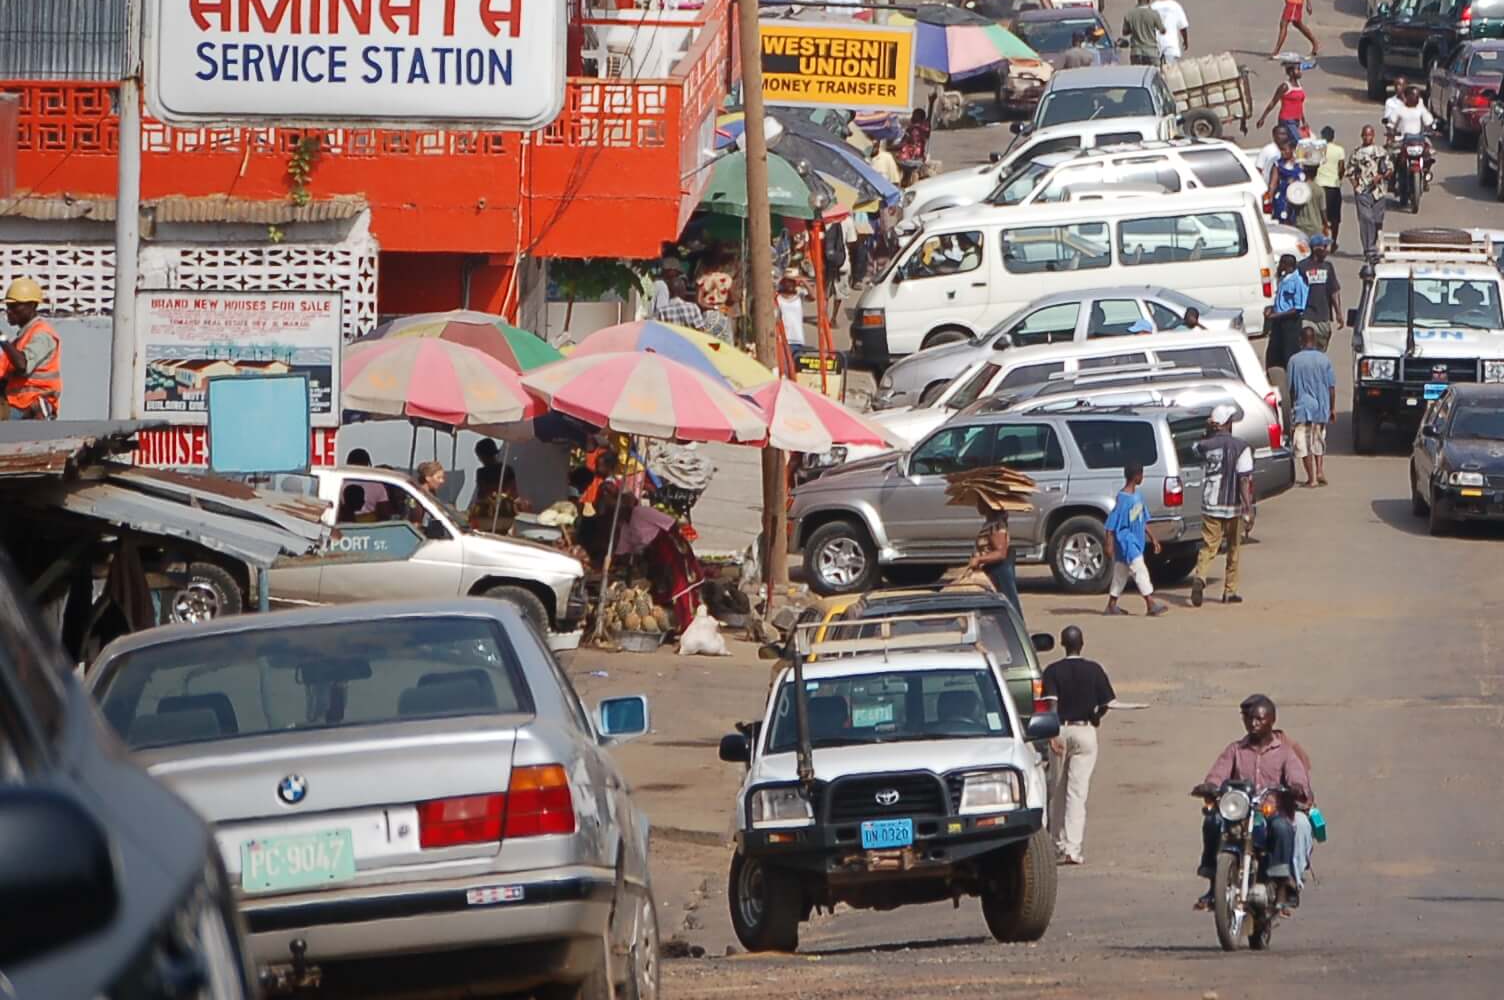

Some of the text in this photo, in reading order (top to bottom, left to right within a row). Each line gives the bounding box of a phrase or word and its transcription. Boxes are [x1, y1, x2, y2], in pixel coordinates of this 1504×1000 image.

[763, 36, 879, 59] WESTERN
[194, 42, 513, 86] SERVICE STATION
[799, 56, 878, 78] UNION
[816, 80, 897, 97] TRANSFER
[151, 298, 330, 312] BRAND NEW HOUSES FOR SALE
[1414, 330, 1463, 340] UN
[373, 541, 389, 550] ST.
